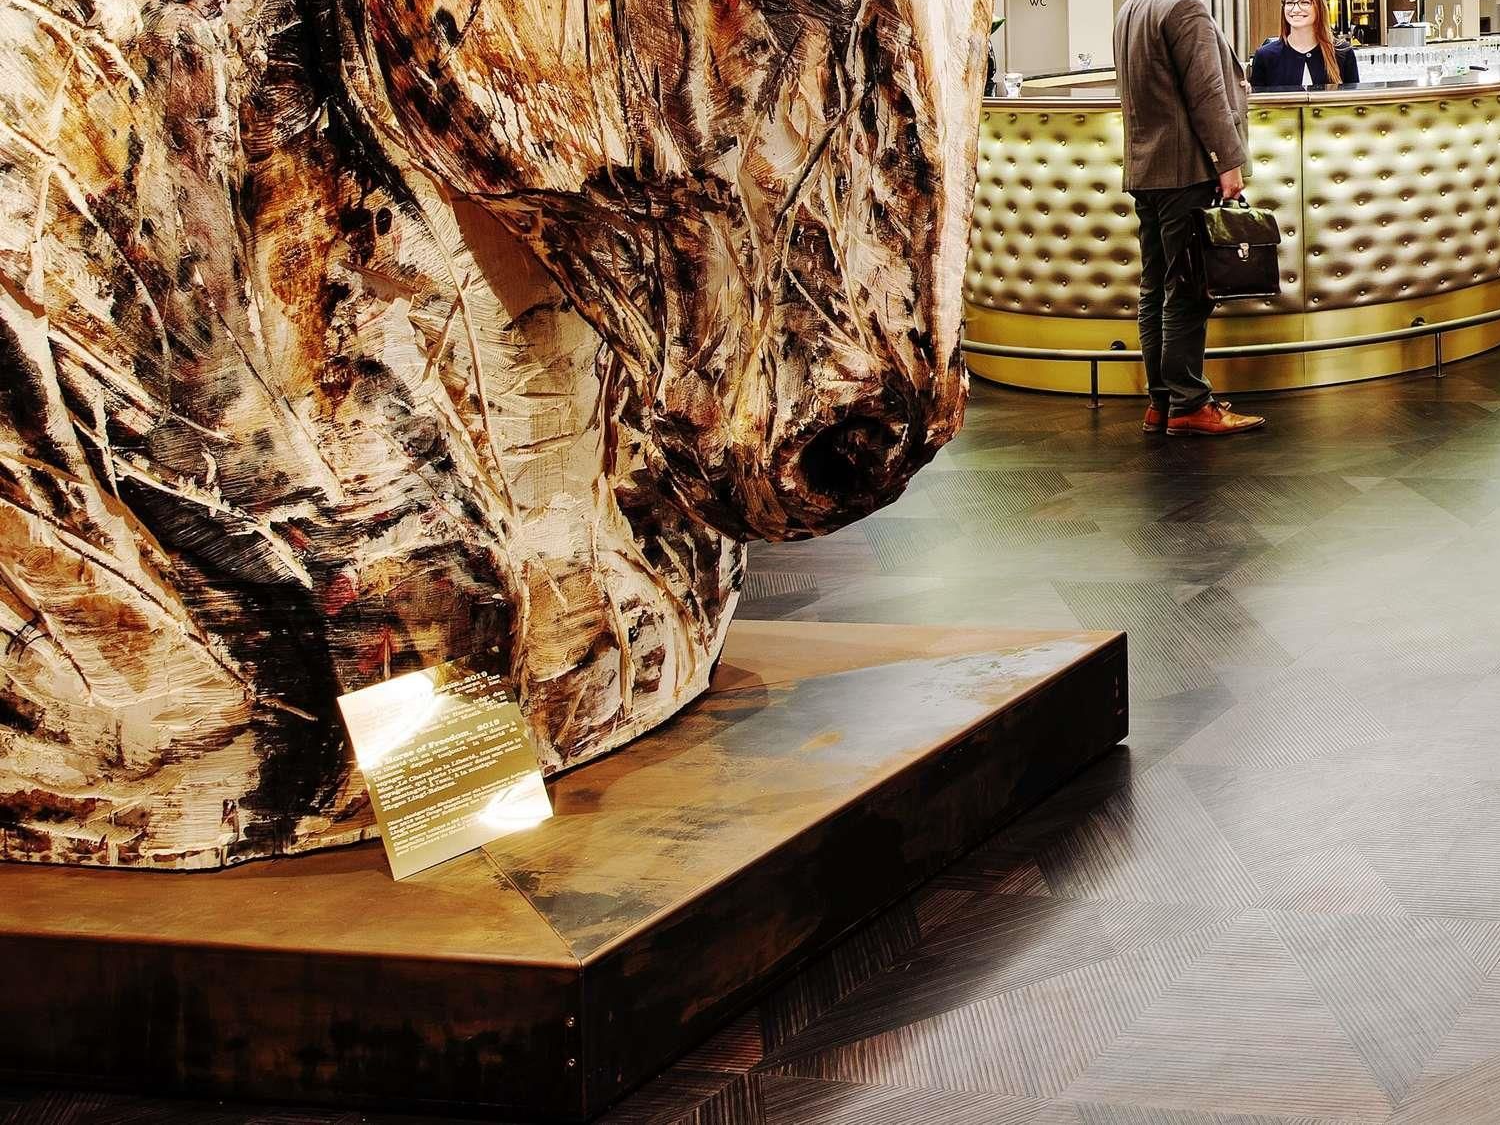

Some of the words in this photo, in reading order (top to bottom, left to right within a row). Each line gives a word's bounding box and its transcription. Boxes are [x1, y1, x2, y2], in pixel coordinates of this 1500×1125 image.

[463, 670, 488, 684] 2019
[416, 744, 428, 753] of
[476, 718, 500, 732] 2019
